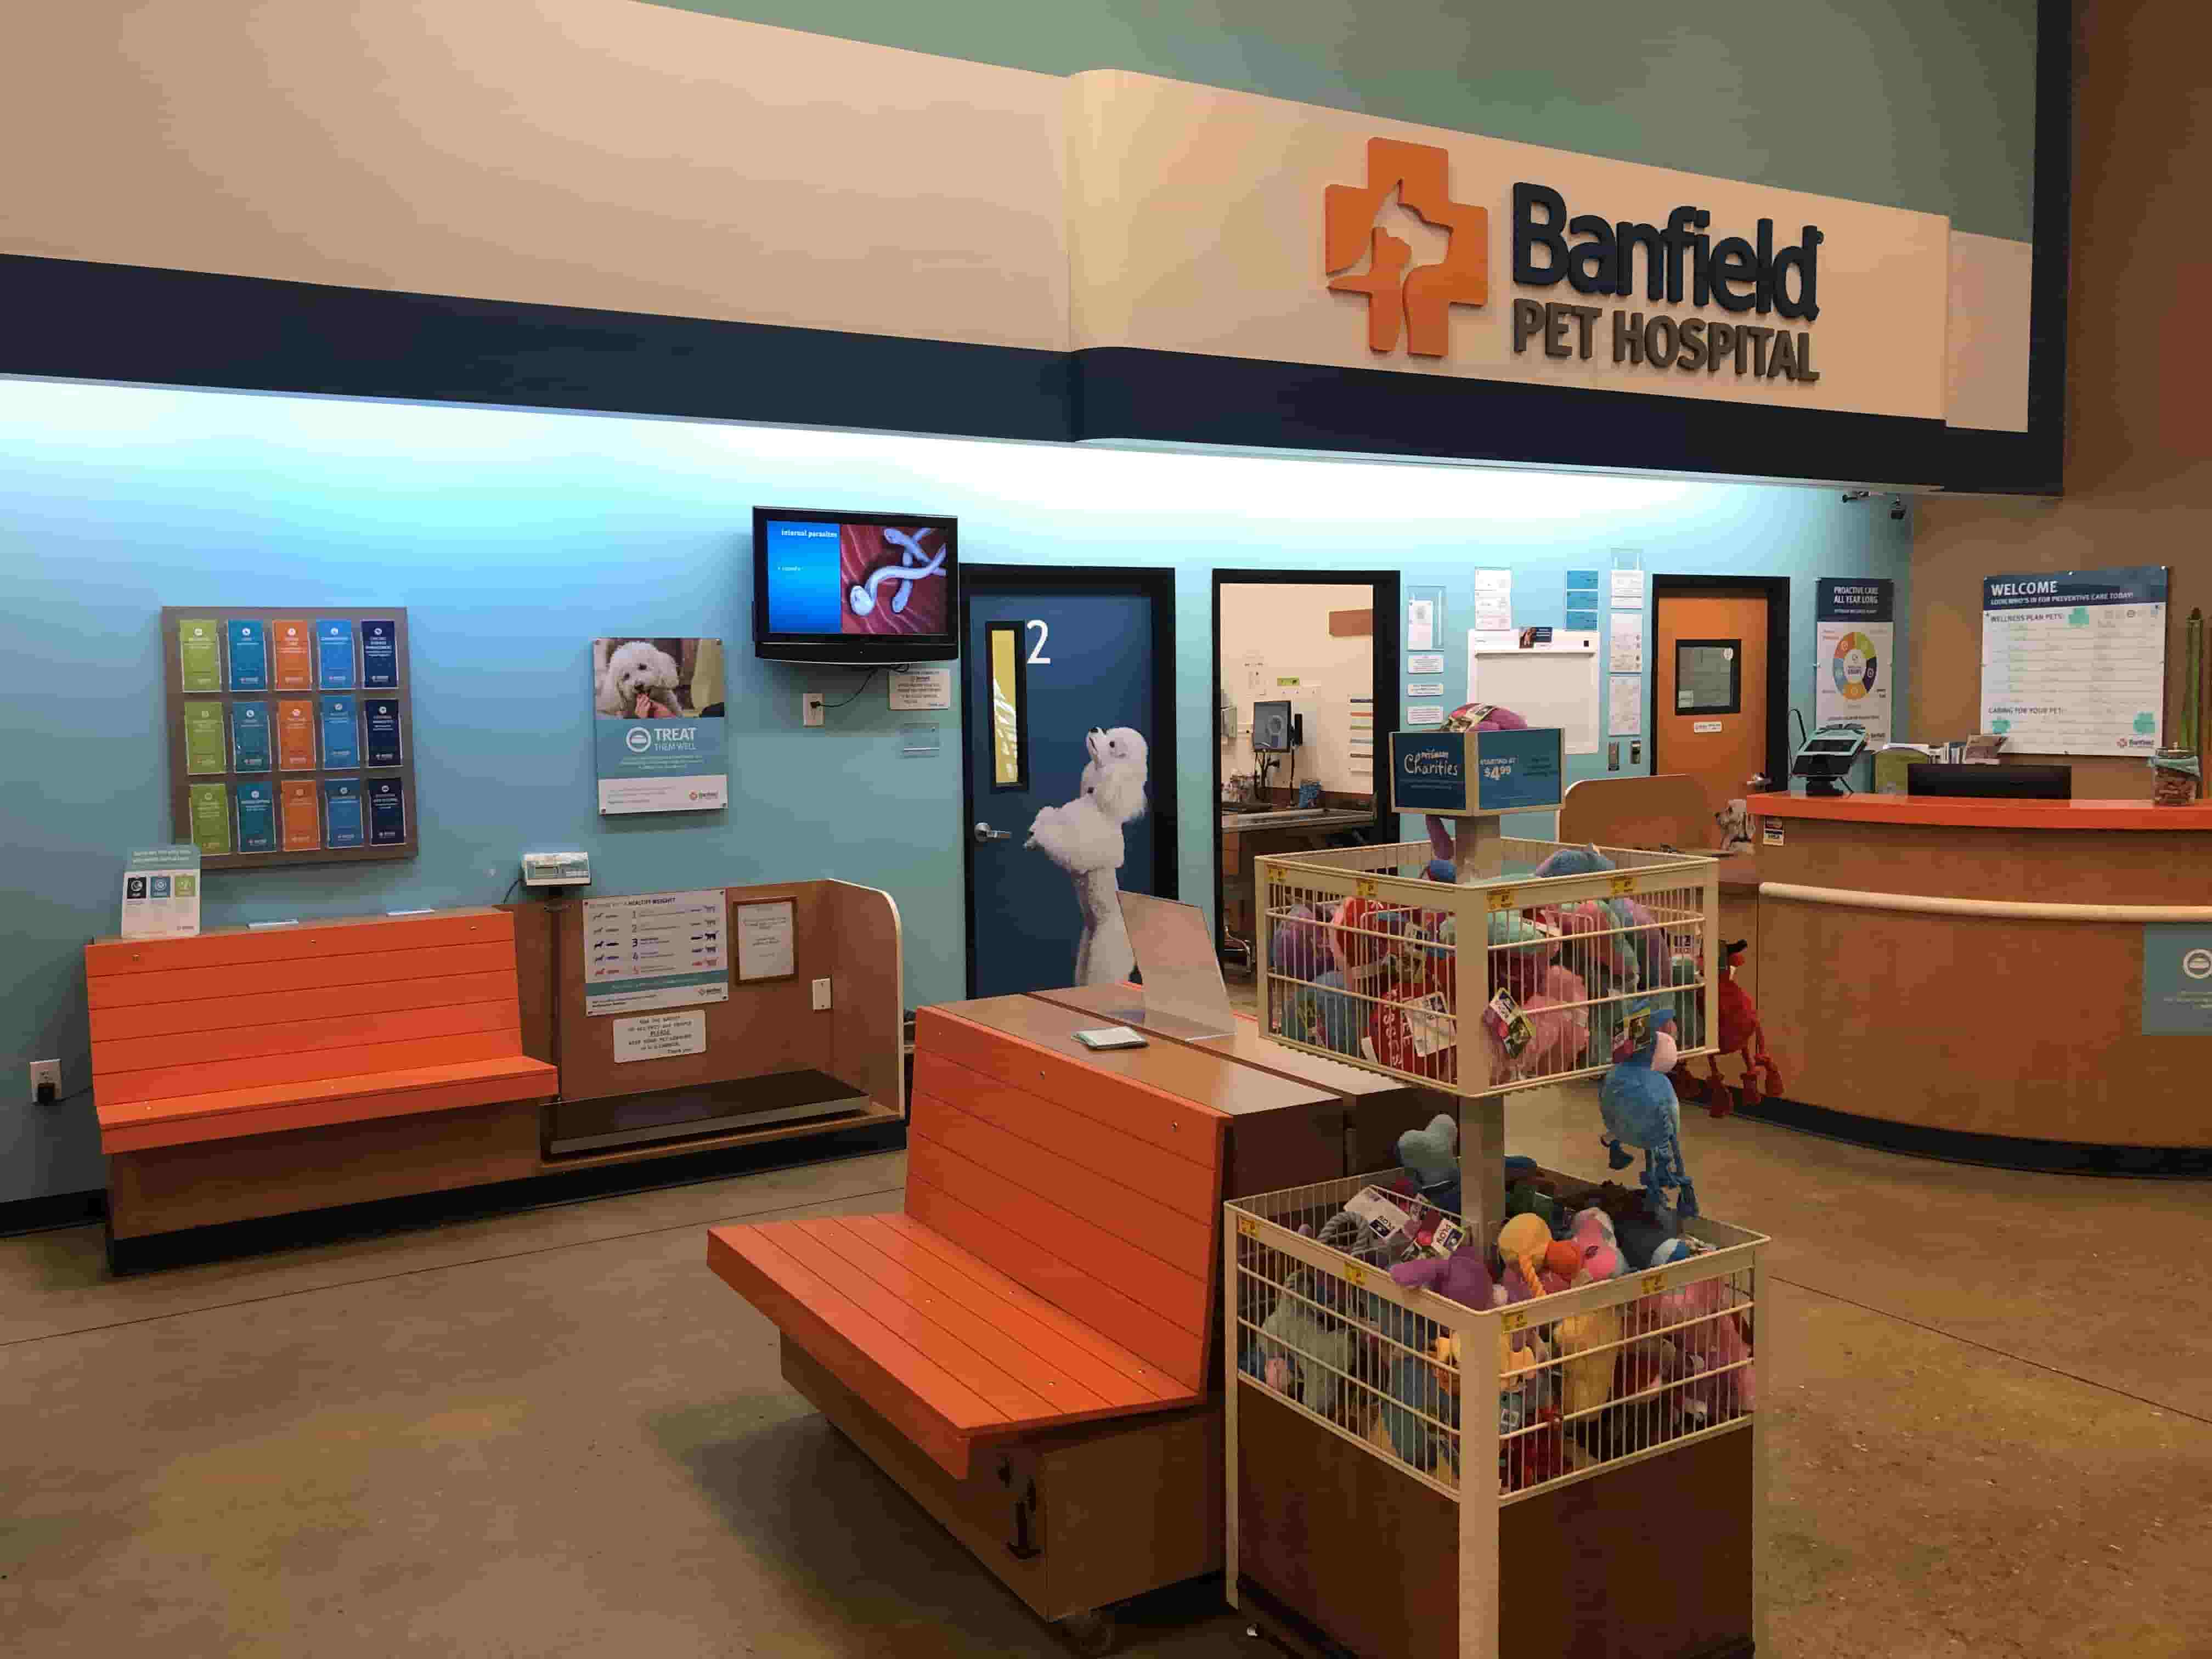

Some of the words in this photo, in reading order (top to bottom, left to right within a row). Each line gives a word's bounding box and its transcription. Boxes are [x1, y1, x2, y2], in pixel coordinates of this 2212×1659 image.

[1513, 182, 1821, 321] Banfield
[1513, 298, 1602, 359] PET
[1612, 309, 1820, 382] HOSPITAL
[1991, 580, 2058, 596] WELCOME
[1026, 619, 1051, 664] 2
[653, 727, 697, 741] TREAT
[1404, 753, 1458, 777] Charities
[631, 938, 638, 947] 3
